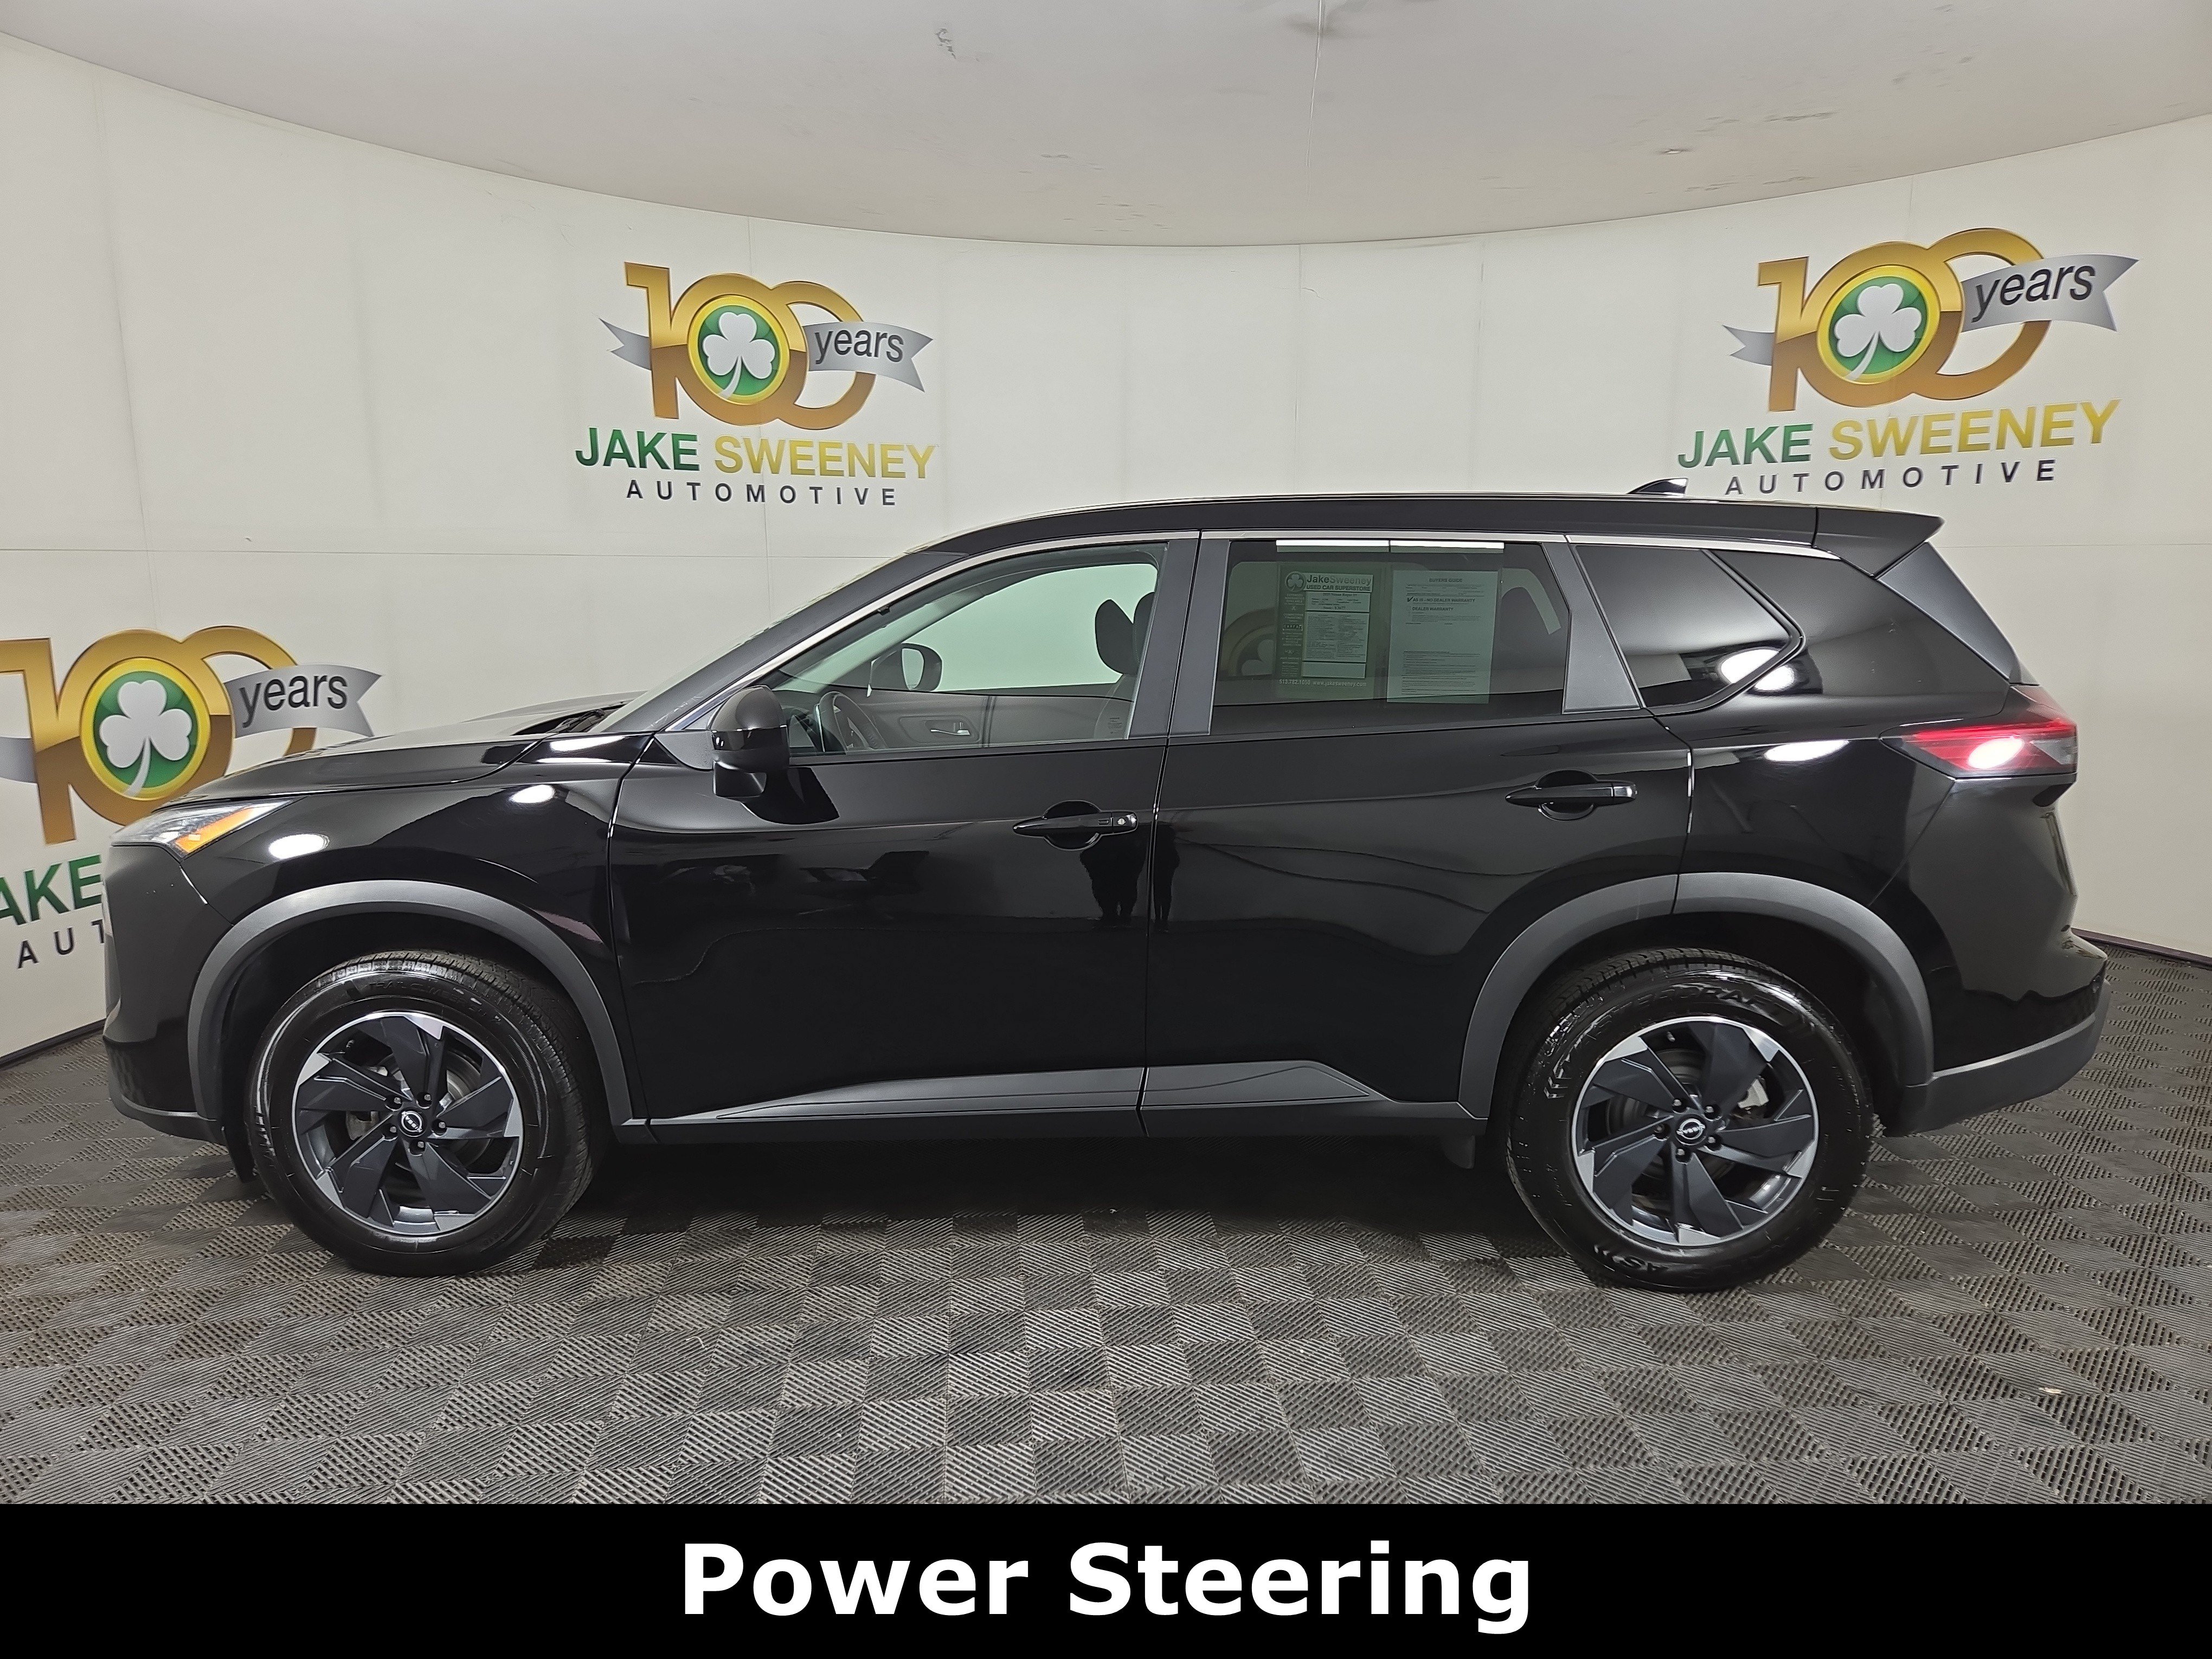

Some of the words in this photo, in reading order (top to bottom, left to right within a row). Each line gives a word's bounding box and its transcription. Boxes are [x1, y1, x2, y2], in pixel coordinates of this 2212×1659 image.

[625, 261, 877, 430] 100
[814, 329, 904, 364] years
[1757, 227, 2047, 412] 100
[1970, 263, 2096, 324] years
[575, 427, 700, 472] JAKE
[714, 435, 937, 479] SWEENEY
[1677, 423, 1814, 468] JAKE
[1829, 398, 2122, 460] SWEENEY
[626, 479, 897, 506] AUTOMOTIVE
[1725, 459, 2057, 496] AUTOMOTIVE
[239, 674, 349, 728] years
